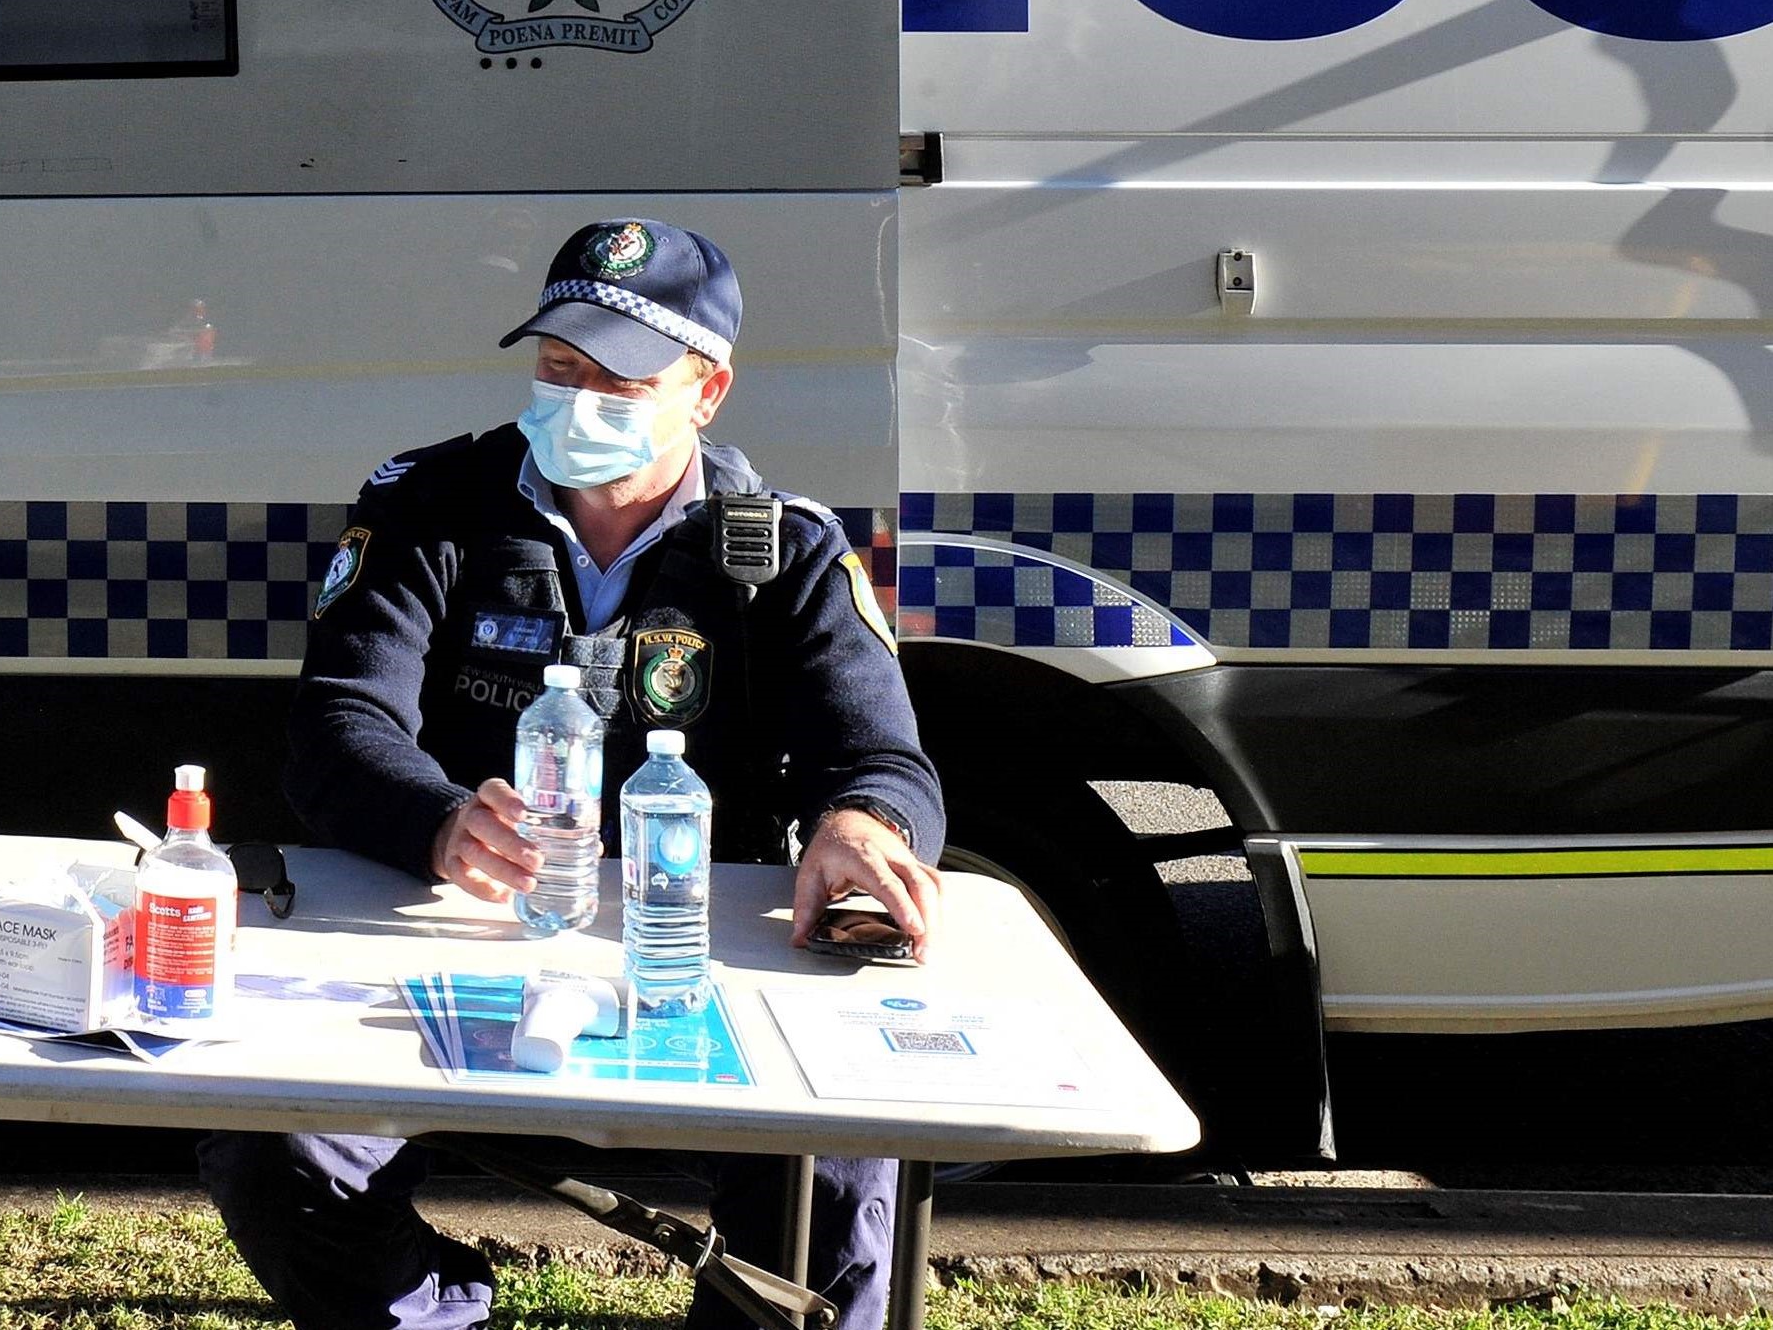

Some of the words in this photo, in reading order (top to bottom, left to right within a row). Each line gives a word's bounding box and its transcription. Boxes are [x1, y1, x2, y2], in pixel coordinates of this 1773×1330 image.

[489, 23, 555, 46] POENA
[561, 23, 641, 47] PREMIT
[454, 674, 537, 712] POLIC
[22, 924, 57, 942] MASK
